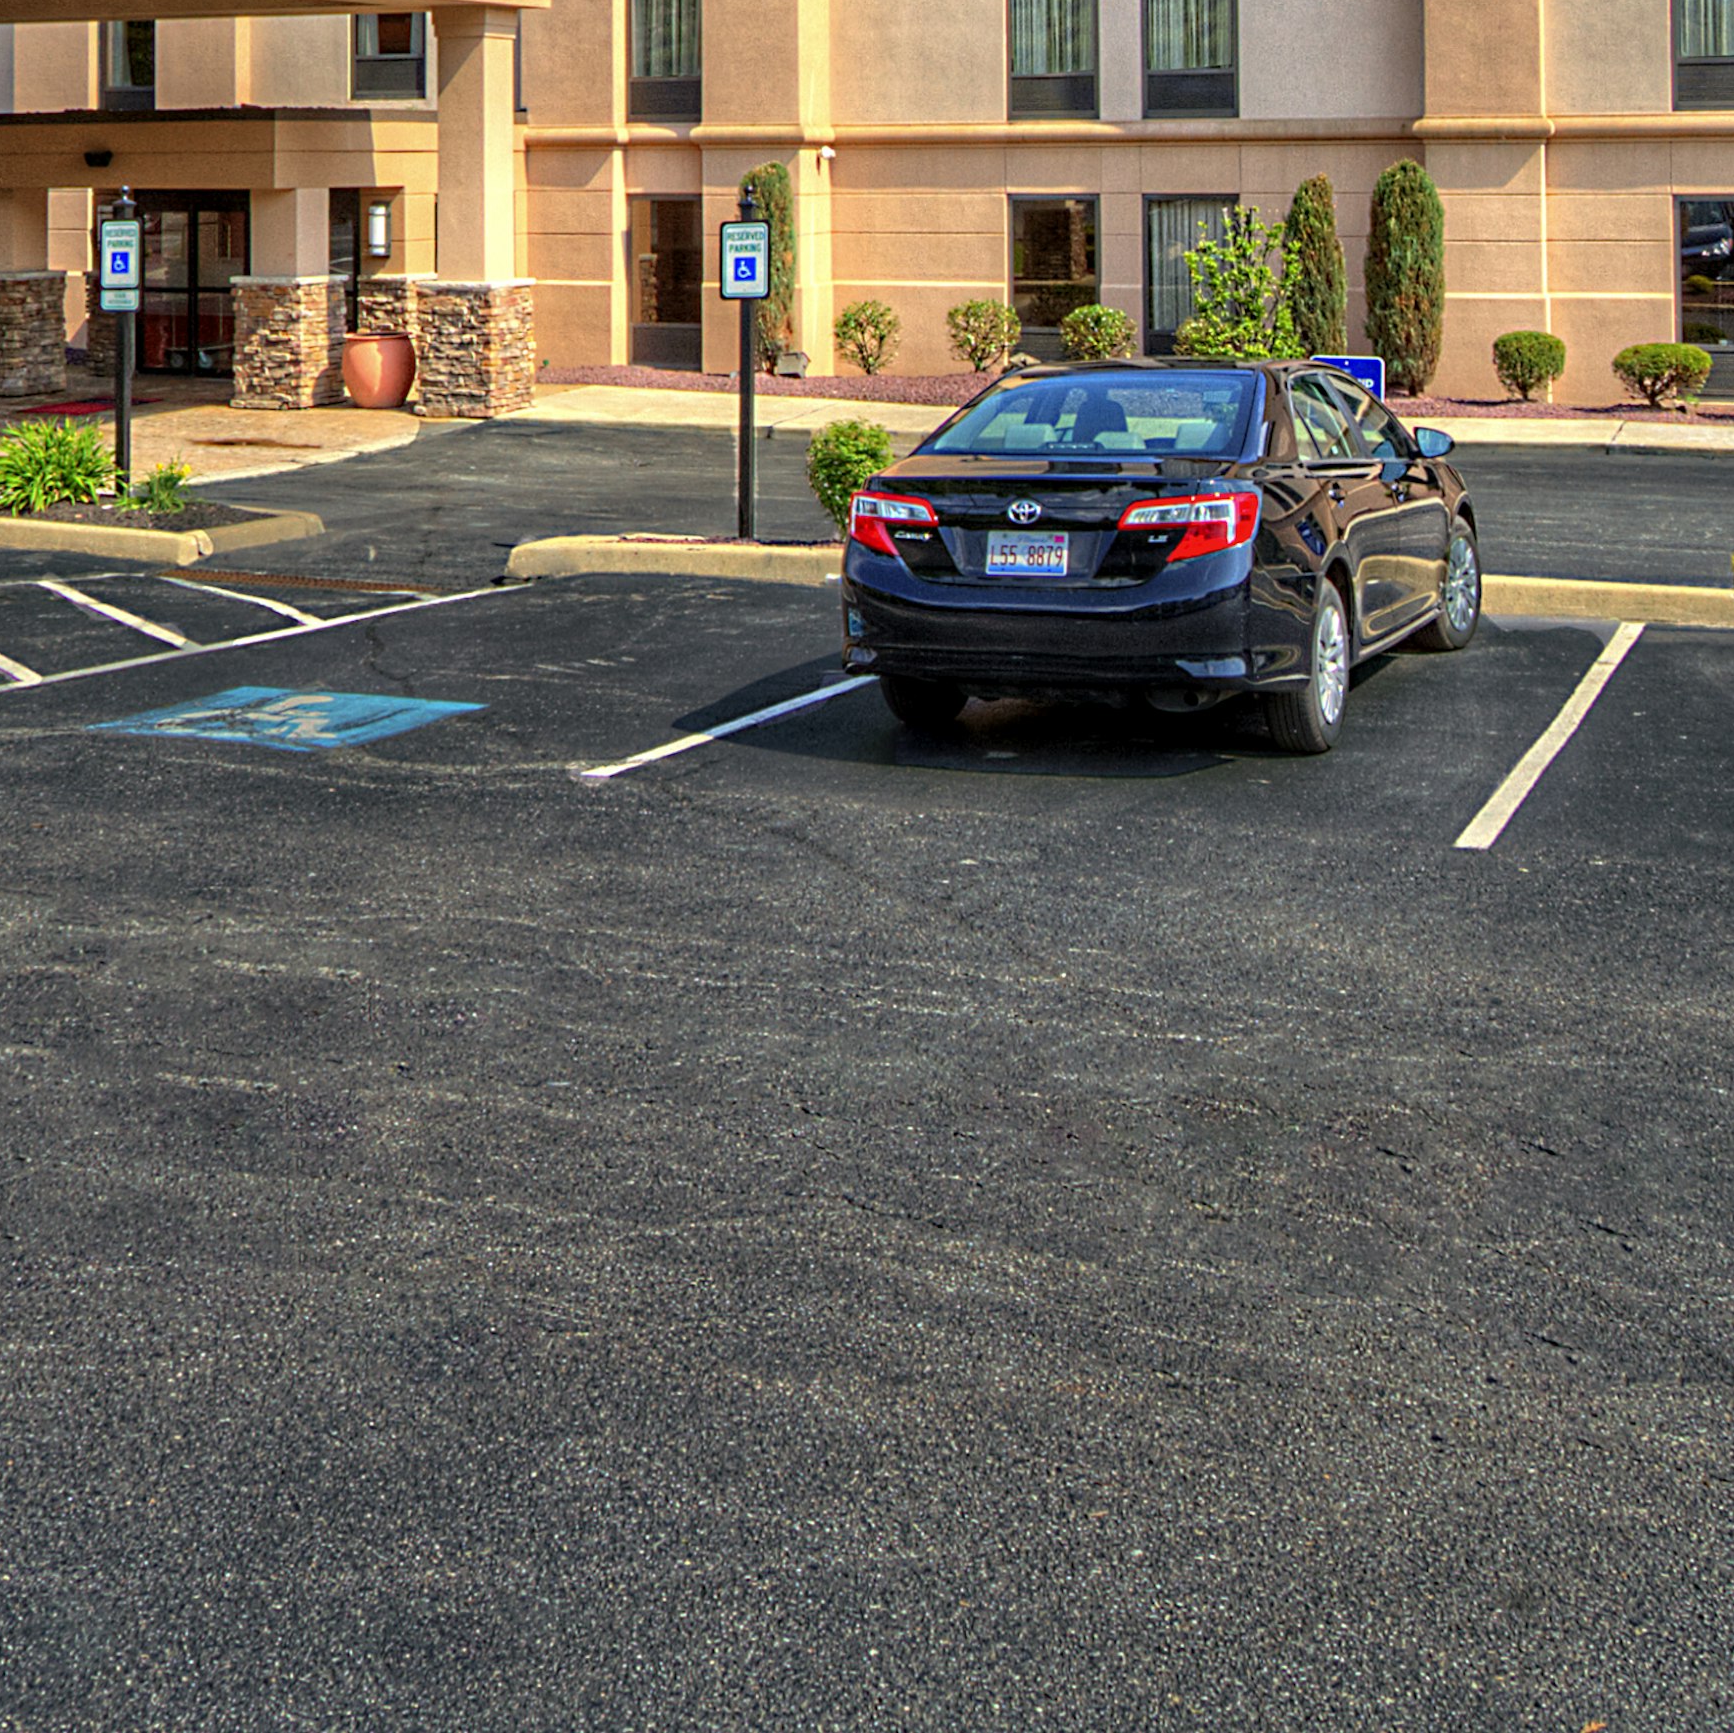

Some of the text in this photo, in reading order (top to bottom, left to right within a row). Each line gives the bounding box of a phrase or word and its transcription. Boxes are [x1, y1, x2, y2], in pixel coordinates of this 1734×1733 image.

[727, 231, 765, 241] RESERVED
[729, 243, 762, 253] PARKING
[990, 545, 1063, 567] L55 8879
